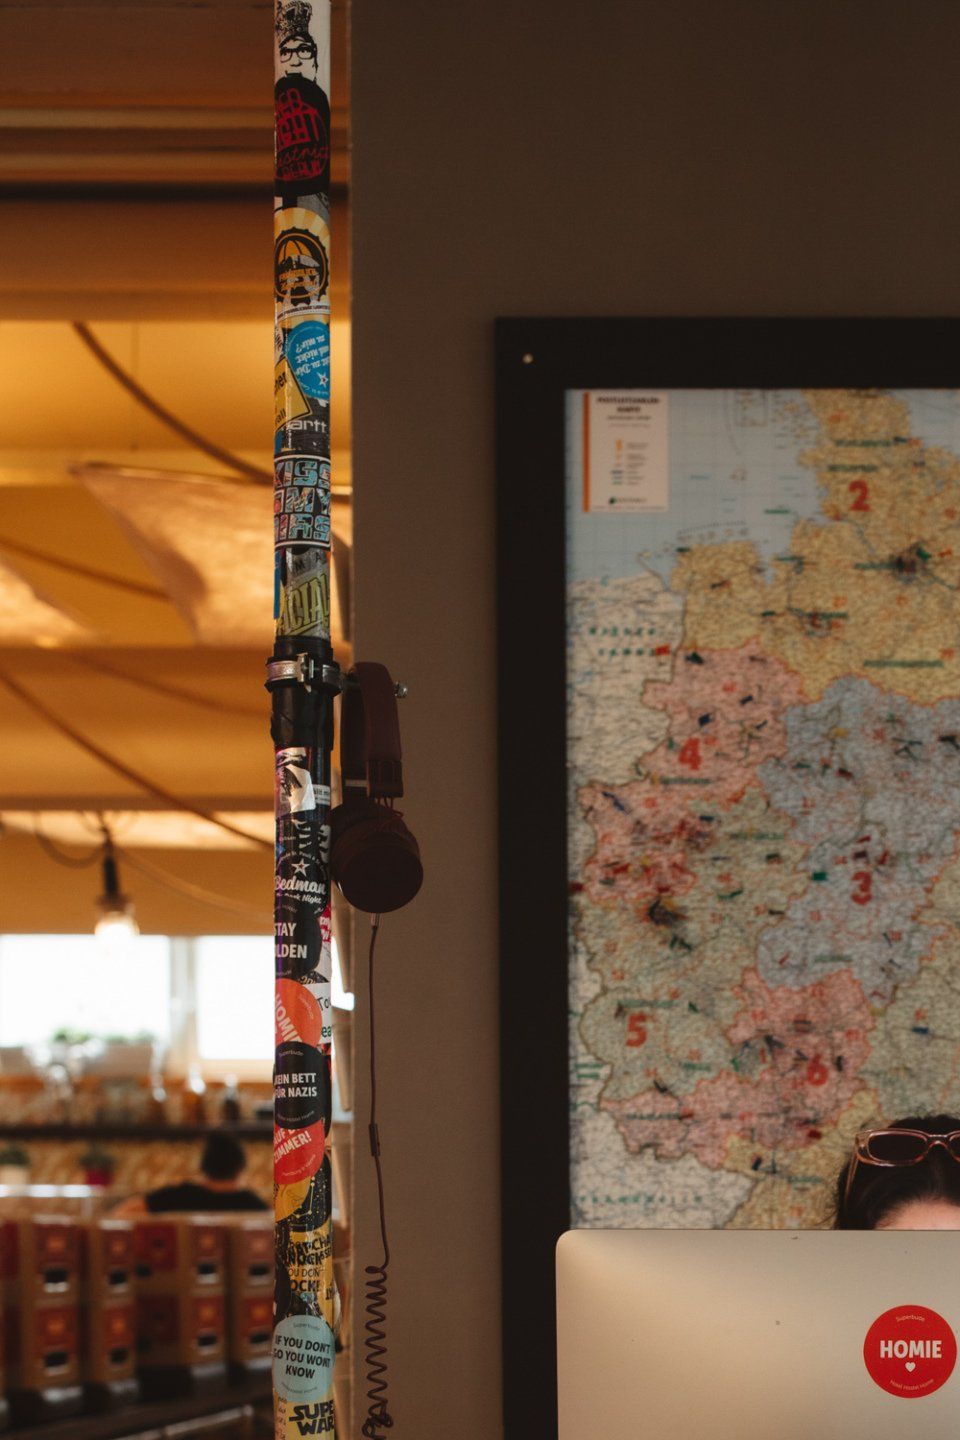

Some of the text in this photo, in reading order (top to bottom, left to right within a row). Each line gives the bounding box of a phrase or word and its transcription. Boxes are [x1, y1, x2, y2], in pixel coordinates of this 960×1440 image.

[848, 479, 870, 513] 2
[678, 737, 703, 771] 4
[850, 870, 873, 906] 3
[625, 1013, 649, 1049] 5
[274, 1072, 316, 1086] KEIN BETT
[806, 1054, 830, 1087] 6
[275, 1086, 317, 1098] FÜR NAZIS
[275, 1334, 282, 1346] IF
[283, 1335, 303, 1349] YOU
[880, 1339, 942, 1359] HOMIE
[284, 1352, 305, 1364] YOU
[285, 1364, 315, 1379] KNOW
[289, 1400, 334, 1422] SUPE
[297, 1419, 334, 1437] WAR
